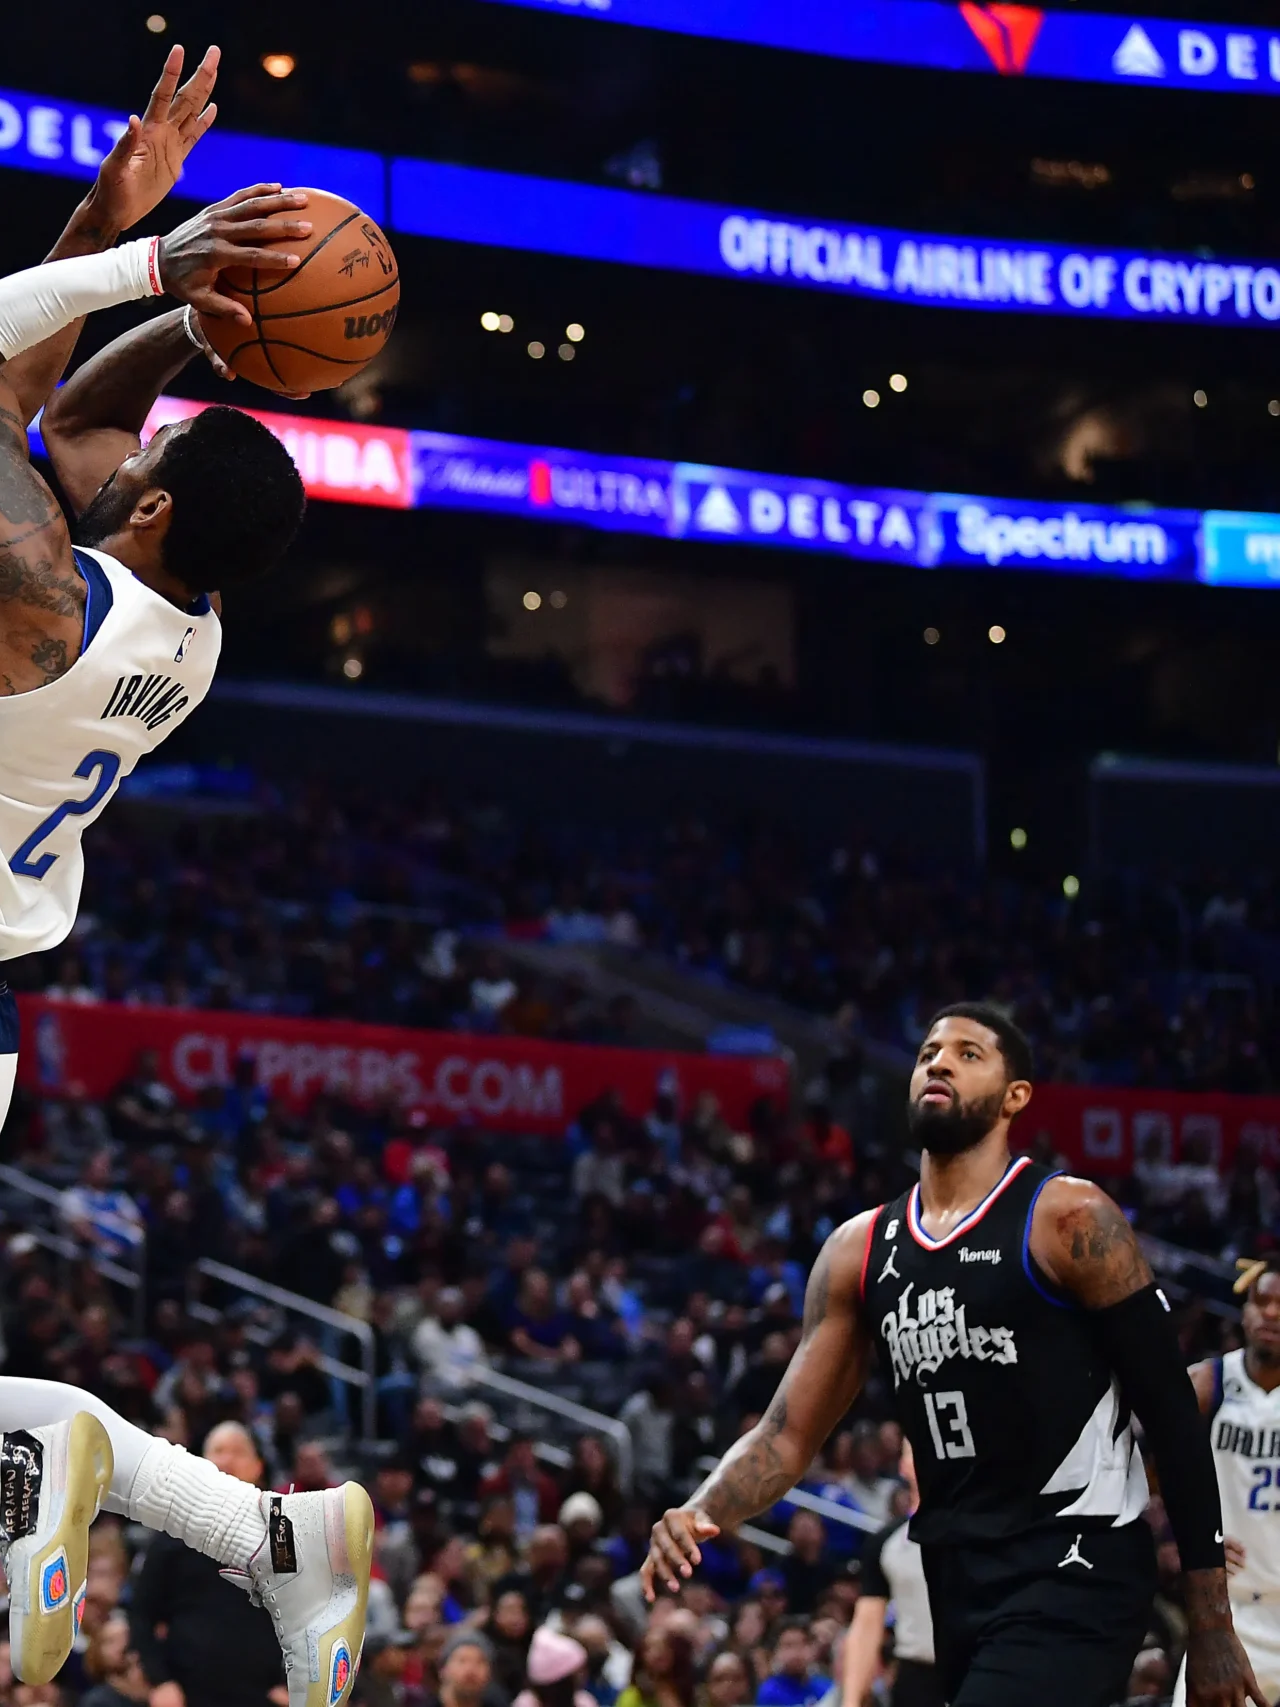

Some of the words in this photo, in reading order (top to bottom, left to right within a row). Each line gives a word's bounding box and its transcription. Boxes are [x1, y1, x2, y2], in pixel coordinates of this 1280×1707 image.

[719, 215, 890, 291] OFFICIAL
[893, 240, 1055, 305] AIRLINE
[1059, 254, 1117, 309] OF
[551, 466, 671, 518] ULTRA
[748, 488, 916, 551] DELTA
[956, 505, 1167, 566] Spectrum
[101, 673, 190, 731] IRVING
[8, 748, 121, 881] 2
[884, 1218, 900, 1241] 6
[958, 1246, 1003, 1265] honey
[898, 1281, 956, 1334] Los
[881, 1303, 1018, 1394] Angeles
[923, 1390, 976, 1460] 13
